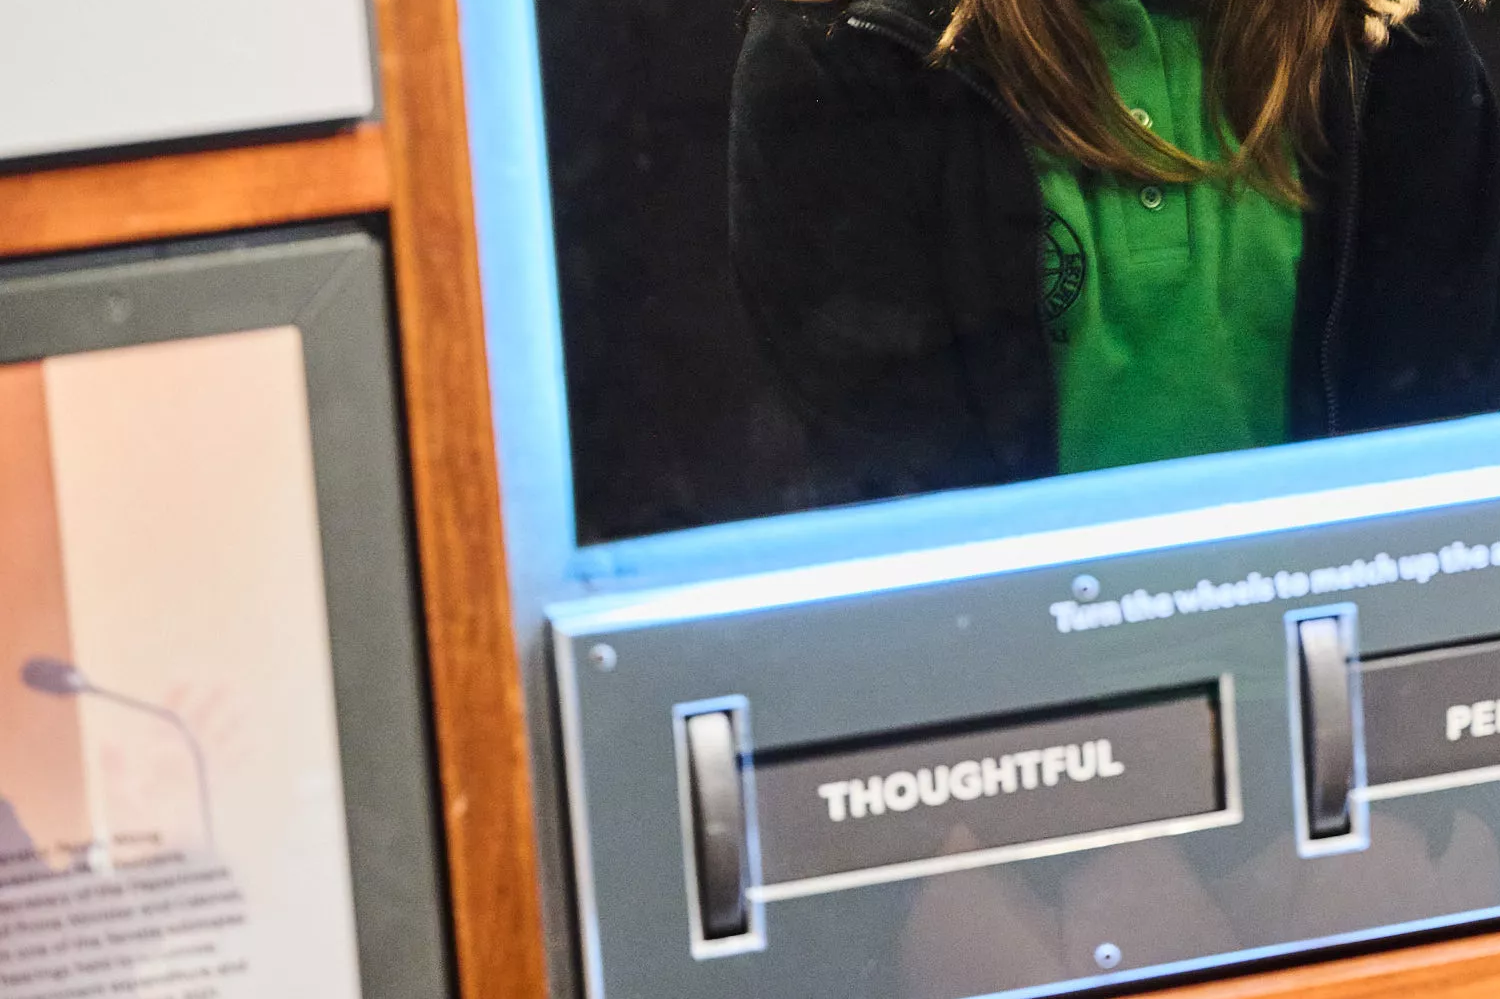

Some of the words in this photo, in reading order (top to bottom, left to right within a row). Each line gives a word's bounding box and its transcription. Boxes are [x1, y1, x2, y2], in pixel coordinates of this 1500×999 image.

[1049, 600, 1123, 633] Turn
[1122, 589, 1175, 623] the
[1174, 572, 1275, 613] wheels
[1275, 571, 1310, 599] to
[1310, 552, 1398, 594] match
[1398, 552, 1440, 584] up
[1438, 541, 1489, 573] the
[818, 739, 1124, 822] THOUGHTFUL
